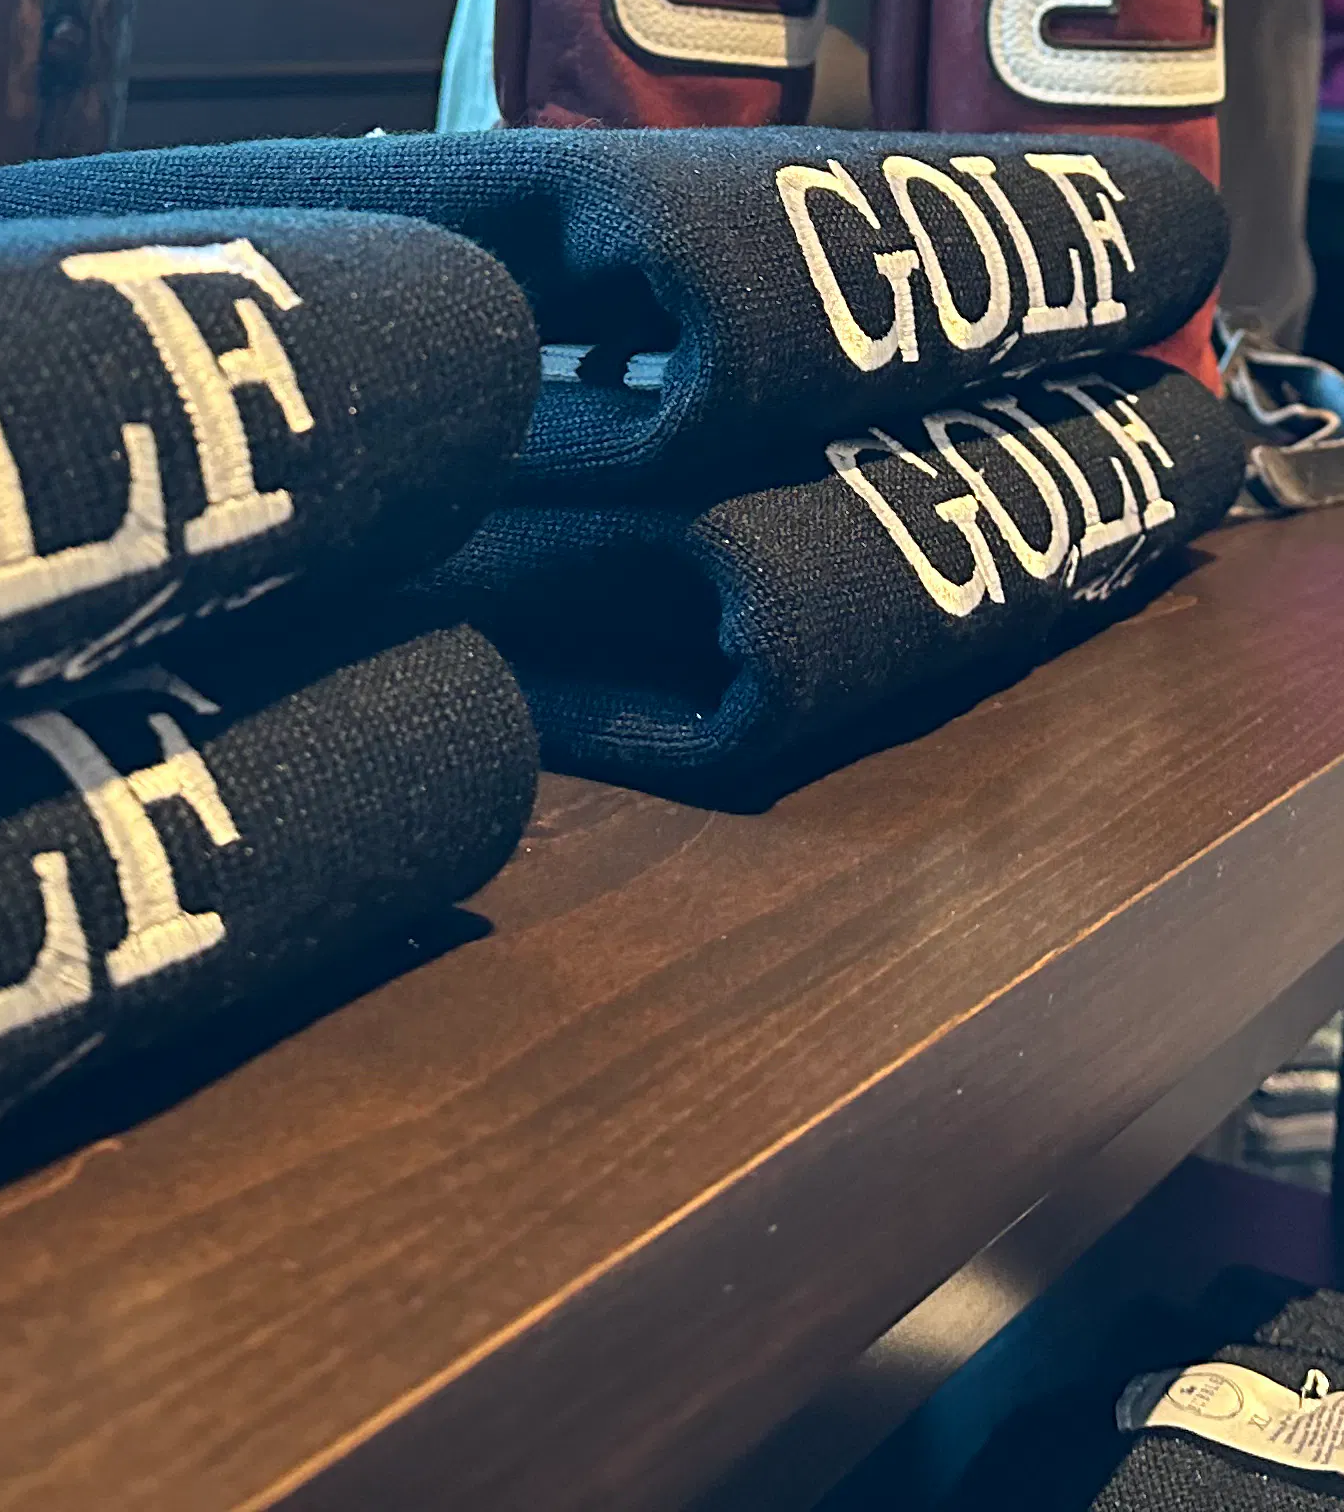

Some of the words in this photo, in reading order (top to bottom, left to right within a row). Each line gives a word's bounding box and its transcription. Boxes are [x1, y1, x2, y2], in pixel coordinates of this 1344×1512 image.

[775, 152, 1138, 373] GOLF
[825, 374, 1176, 618] GOLF
[1247, 1414, 1273, 1432] XL
